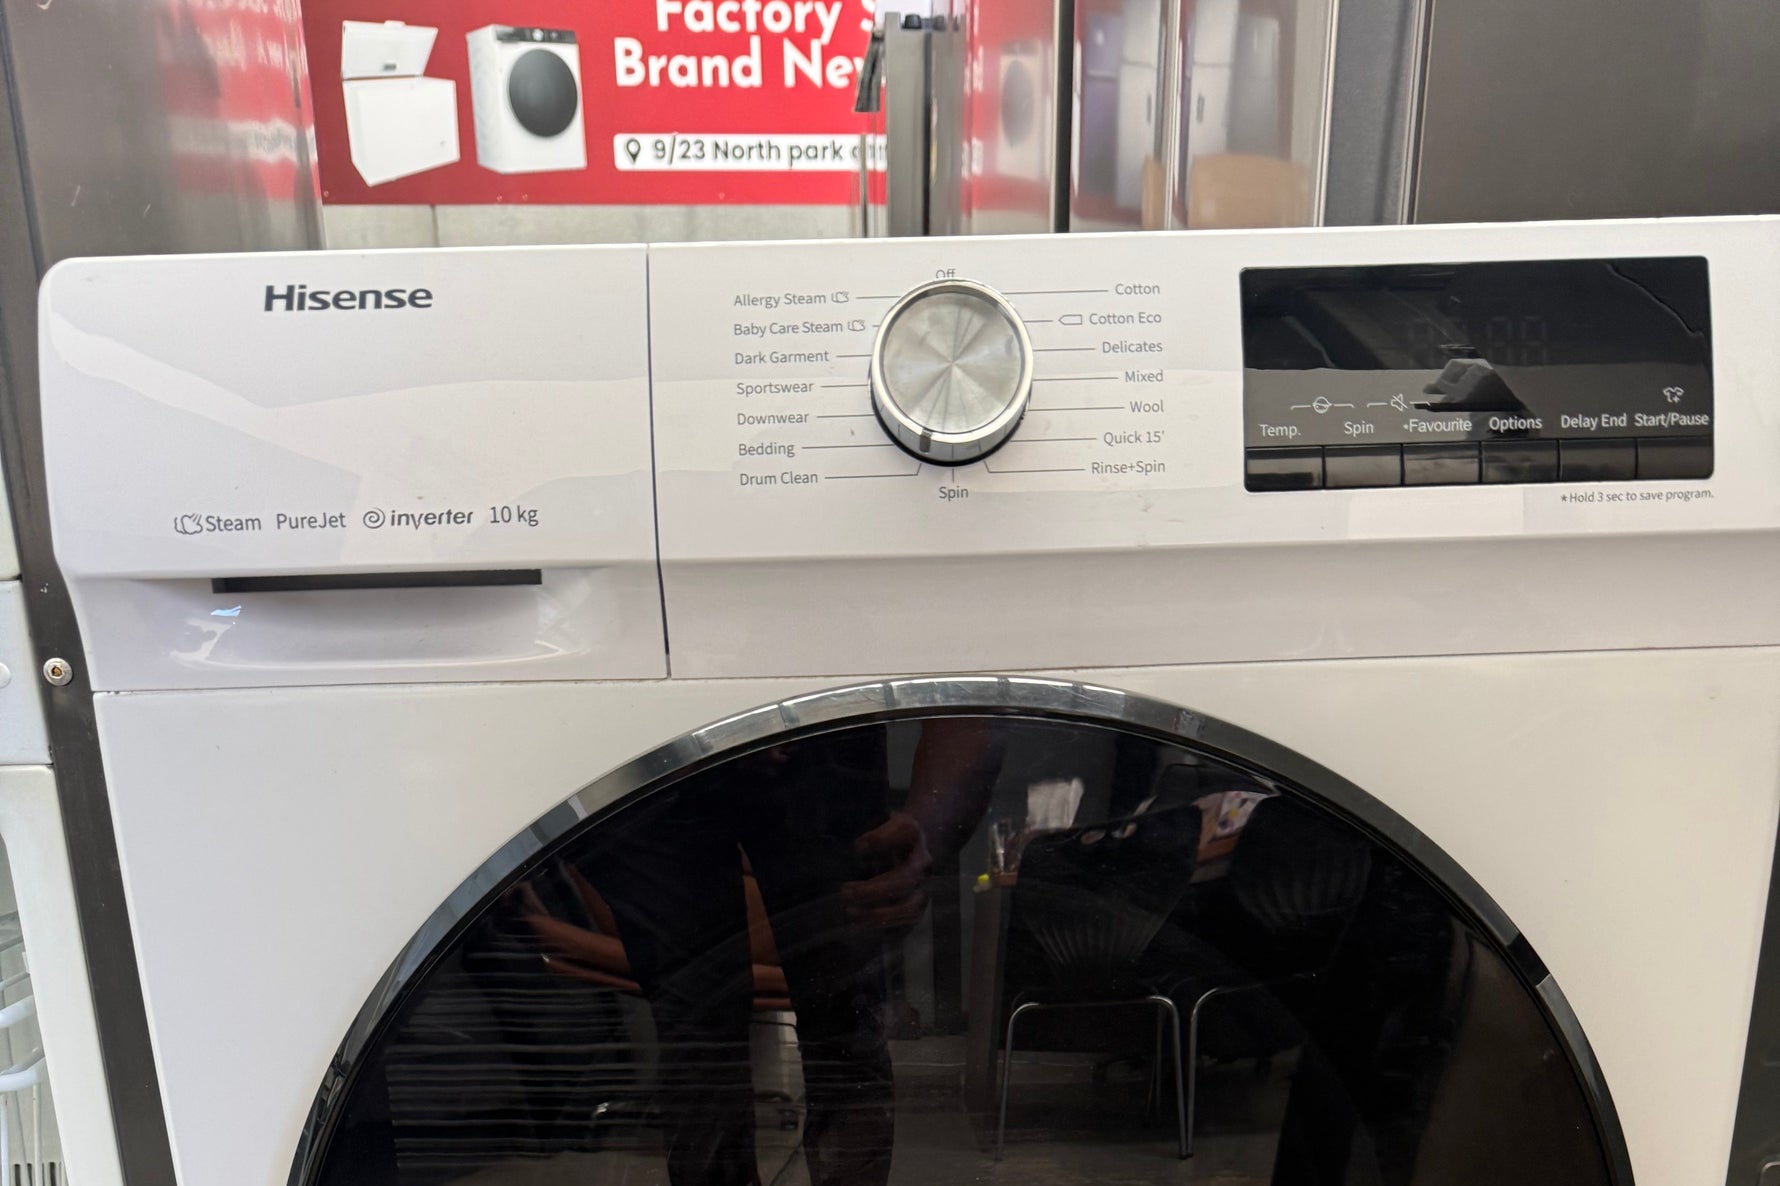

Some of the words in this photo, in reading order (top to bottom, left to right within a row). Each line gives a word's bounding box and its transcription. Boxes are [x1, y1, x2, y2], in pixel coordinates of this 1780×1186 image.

[656, 0, 842, 45] Factory
[614, 35, 762, 87] Brand
[653, 135, 705, 165] 9/23
[713, 139, 780, 161] North
[789, 139, 843, 168] park
[935, 268, 956, 278] Off
[1115, 283, 1160, 296] Cotton
[264, 285, 433, 312] Hisense
[734, 293, 780, 308] Allergy
[784, 292, 826, 305] Steam
[1089, 313, 1134, 326] Cotton
[1138, 312, 1161, 324] Eco
[734, 322, 767, 336] Baby
[770, 321, 799, 335] Care
[802, 320, 843, 333] Steam
[1102, 341, 1163, 354] Delicates
[734, 352, 766, 364] Dark
[770, 350, 829, 363] Garment
[1124, 370, 1164, 383] Mixed
[736, 381, 813, 395] Sportswear
[1130, 401, 1164, 413] Wool
[737, 411, 809, 425] Downwear
[1489, 415, 1542, 431] Options
[1560, 413, 1598, 430] Delay
[1601, 413, 1627, 427] End
[1634, 412, 1709, 428] Start/Pause
[1260, 424, 1301, 438] Temp.
[1344, 420, 1374, 436] Spin
[1103, 431, 1140, 446] Quick
[738, 442, 795, 457] Bedding
[1091, 461, 1166, 475] Rinse+Spin
[740, 473, 778, 485] Drum
[781, 471, 818, 484] Clean
[939, 486, 969, 500] Spin
[1597, 492, 1604, 502] 3
[1606, 493, 1623, 502] sec
[1626, 491, 1637, 501] to
[1639, 492, 1663, 500] save
[1665, 489, 1714, 502] program.
[276, 511, 346, 530] PureJet
[390, 508, 473, 530] inverter
[490, 506, 512, 524] 10
[516, 505, 539, 526] kg
[206, 515, 262, 532] Steam
